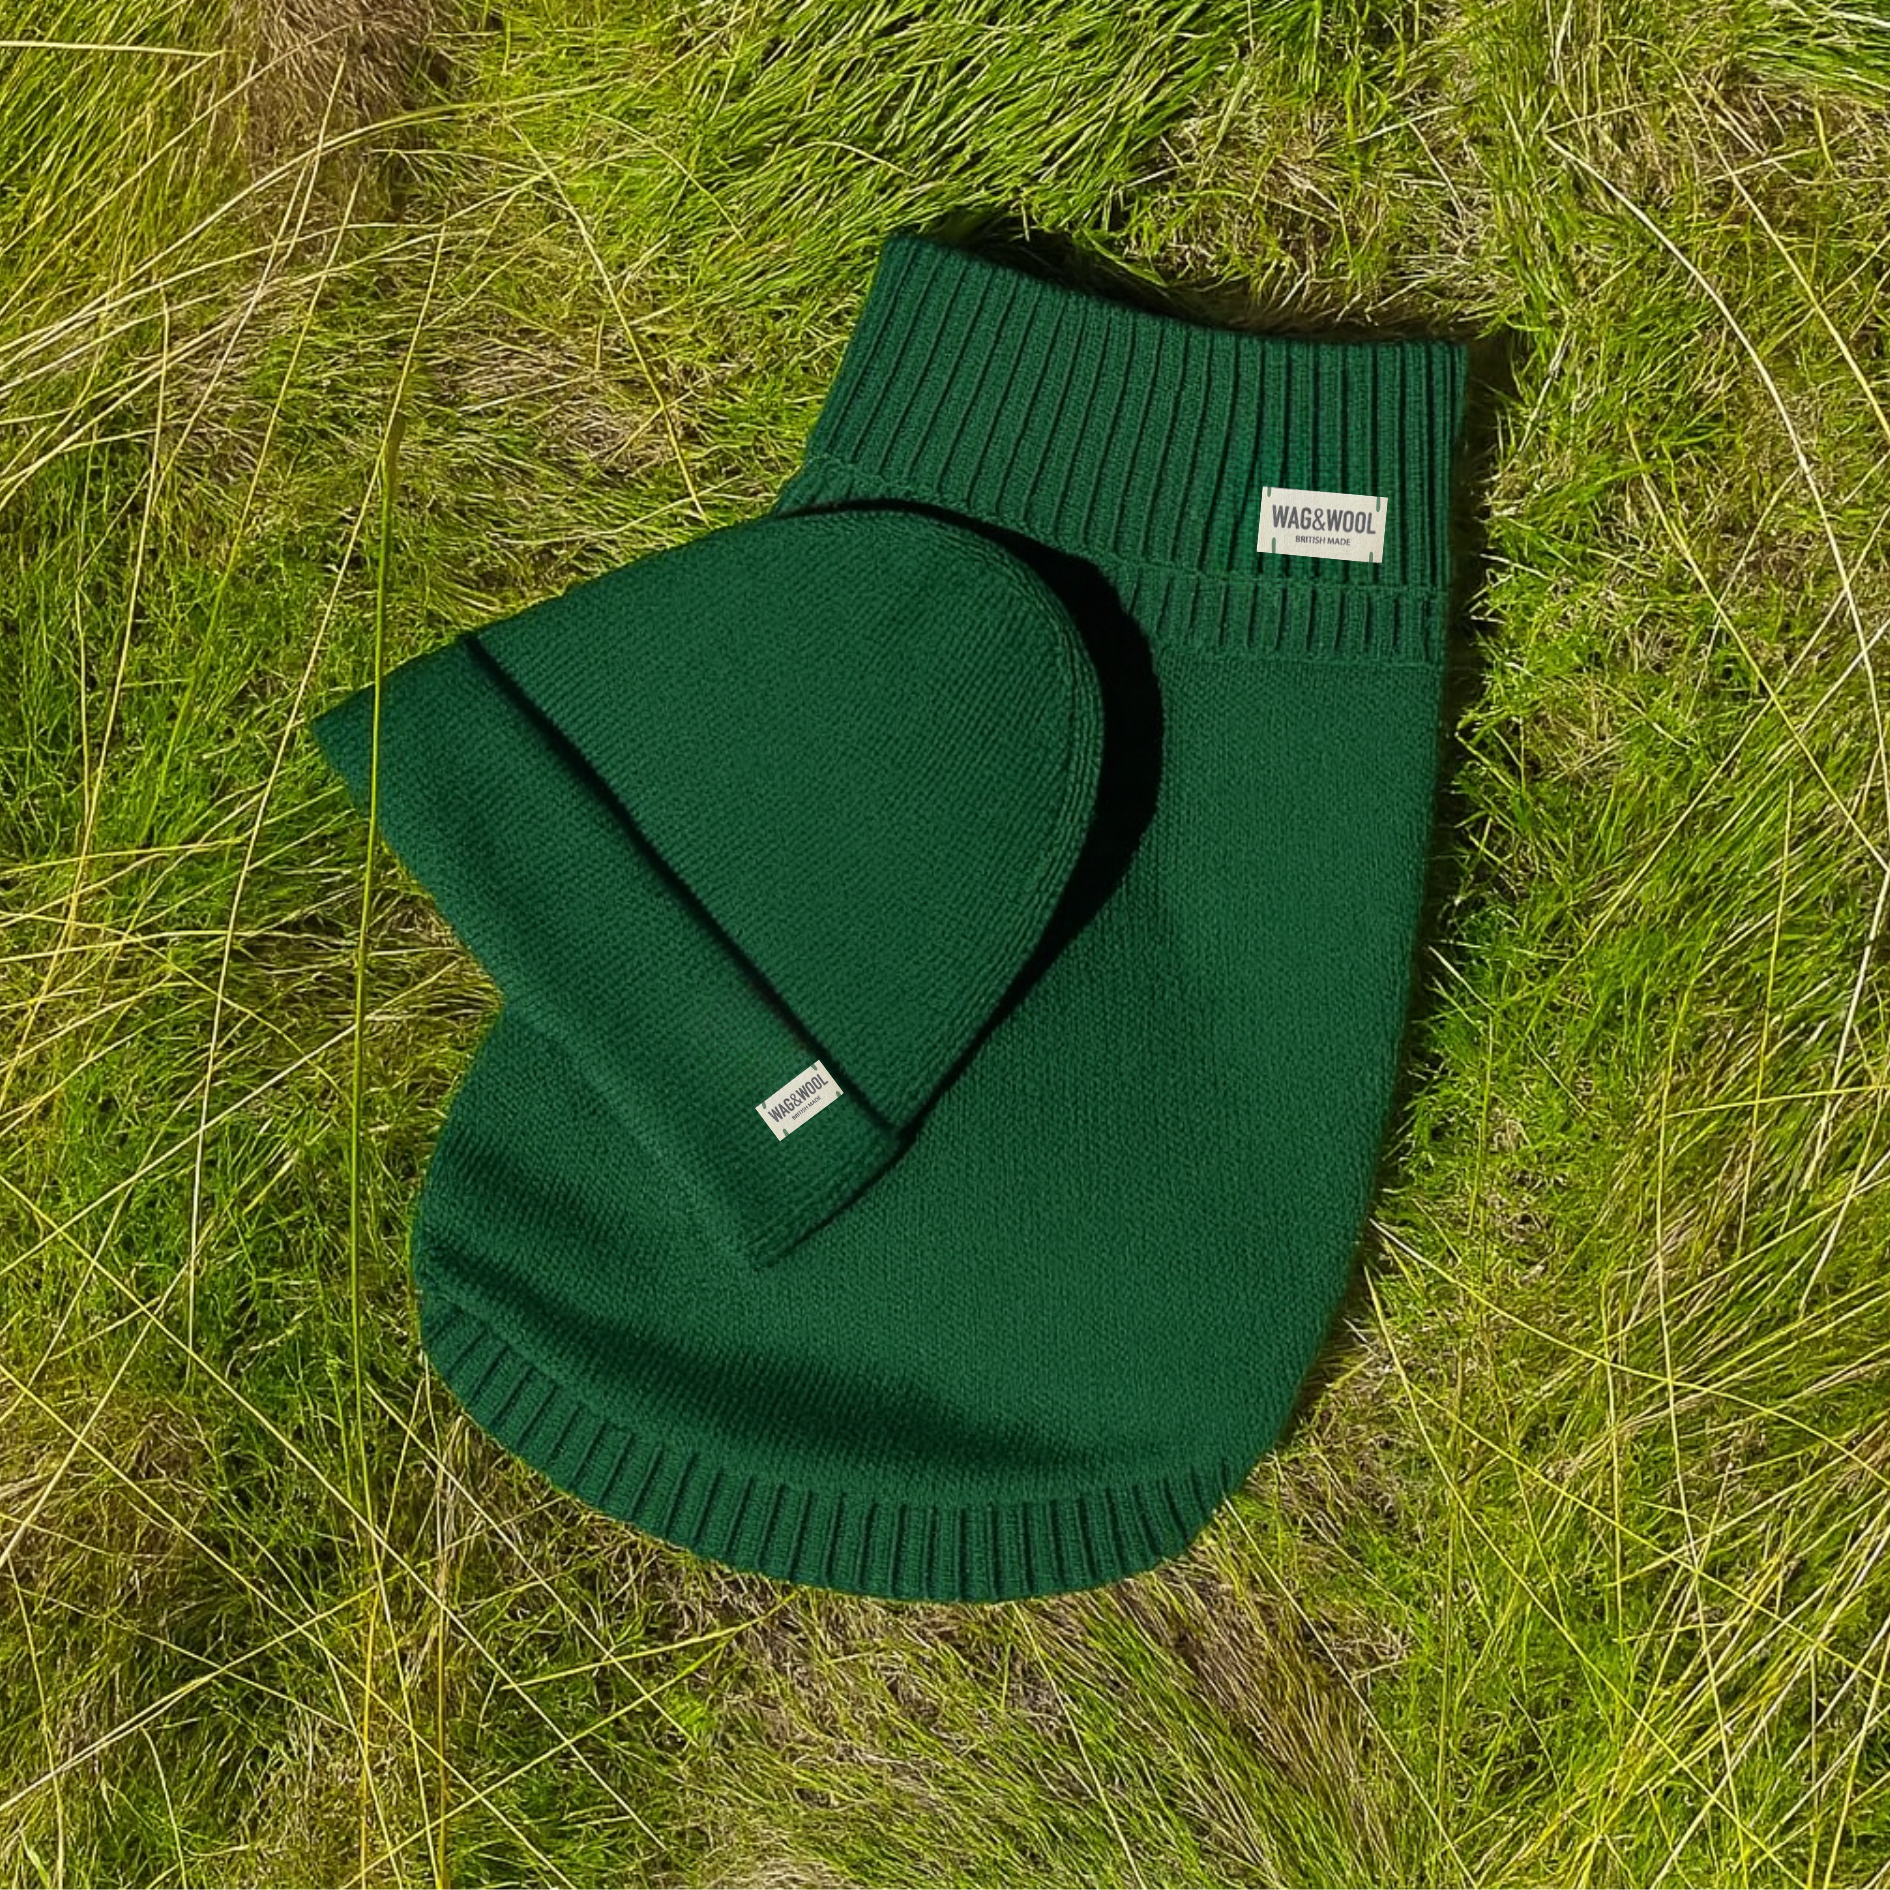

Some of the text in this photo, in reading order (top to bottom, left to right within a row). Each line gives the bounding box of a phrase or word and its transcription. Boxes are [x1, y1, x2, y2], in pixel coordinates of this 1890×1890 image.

[1272, 504, 1376, 534] WAG&WOOL
[1295, 535, 1351, 546] BRITISH MADE
[767, 1073, 829, 1123] WAG&WOOL
[792, 1095, 821, 1120] BRITISH MADE
